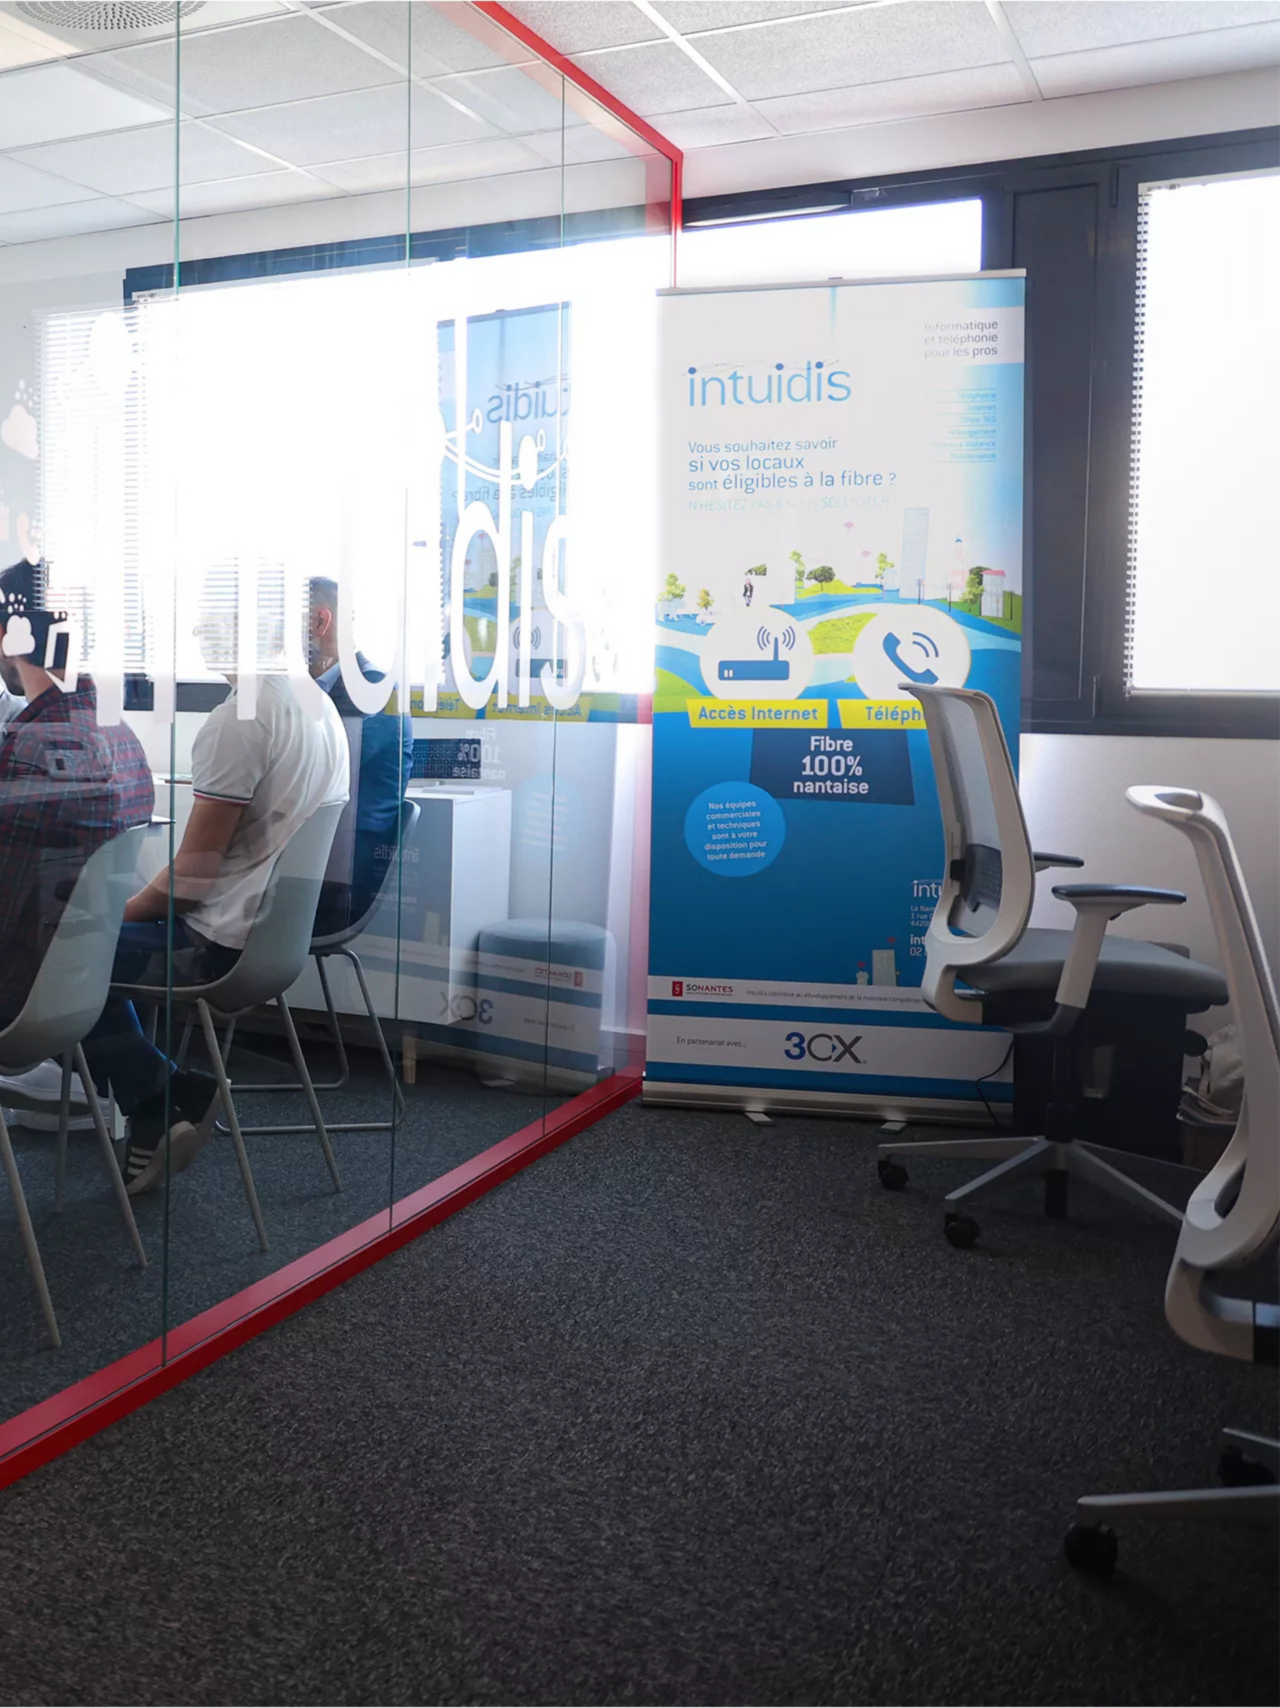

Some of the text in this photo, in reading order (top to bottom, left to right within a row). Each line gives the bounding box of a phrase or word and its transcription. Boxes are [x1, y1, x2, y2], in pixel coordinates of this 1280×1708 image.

[924, 320, 999, 333] Informatique
[924, 336, 935, 345] et
[924, 346, 999, 360] pour les pros
[687, 360, 853, 407] intuidis
[688, 436, 838, 454] Vous souhaitez savoir
[688, 455, 805, 472] si vos locaux
[688, 479, 718, 491] sont
[722, 473, 798, 494] éligibles
[803, 472, 814, 487] à
[820, 471, 835, 487] la
[840, 470, 883, 486] fibre
[698, 704, 925, 725] Accès Internet Téléph
[809, 735, 854, 752] Fibre
[801, 755, 863, 776] 100%
[793, 778, 869, 794] nantaise
[708, 800, 757, 810] Nos équipes
[706, 810, 761, 820] commerciales
[717, 821, 761, 830] techniques
[712, 831, 758, 840] sont à votre
[704, 841, 768, 851] disposition pour
[707, 850, 766, 861] toute demande
[686, 983, 734, 993] SONANTES
[803, 991, 848, 1000] développement
[676, 1036, 686, 1044] En
[687, 1037, 725, 1047] partenariat
[726, 1040, 742, 1048] avec
[784, 1031, 863, 1064] 3CX
